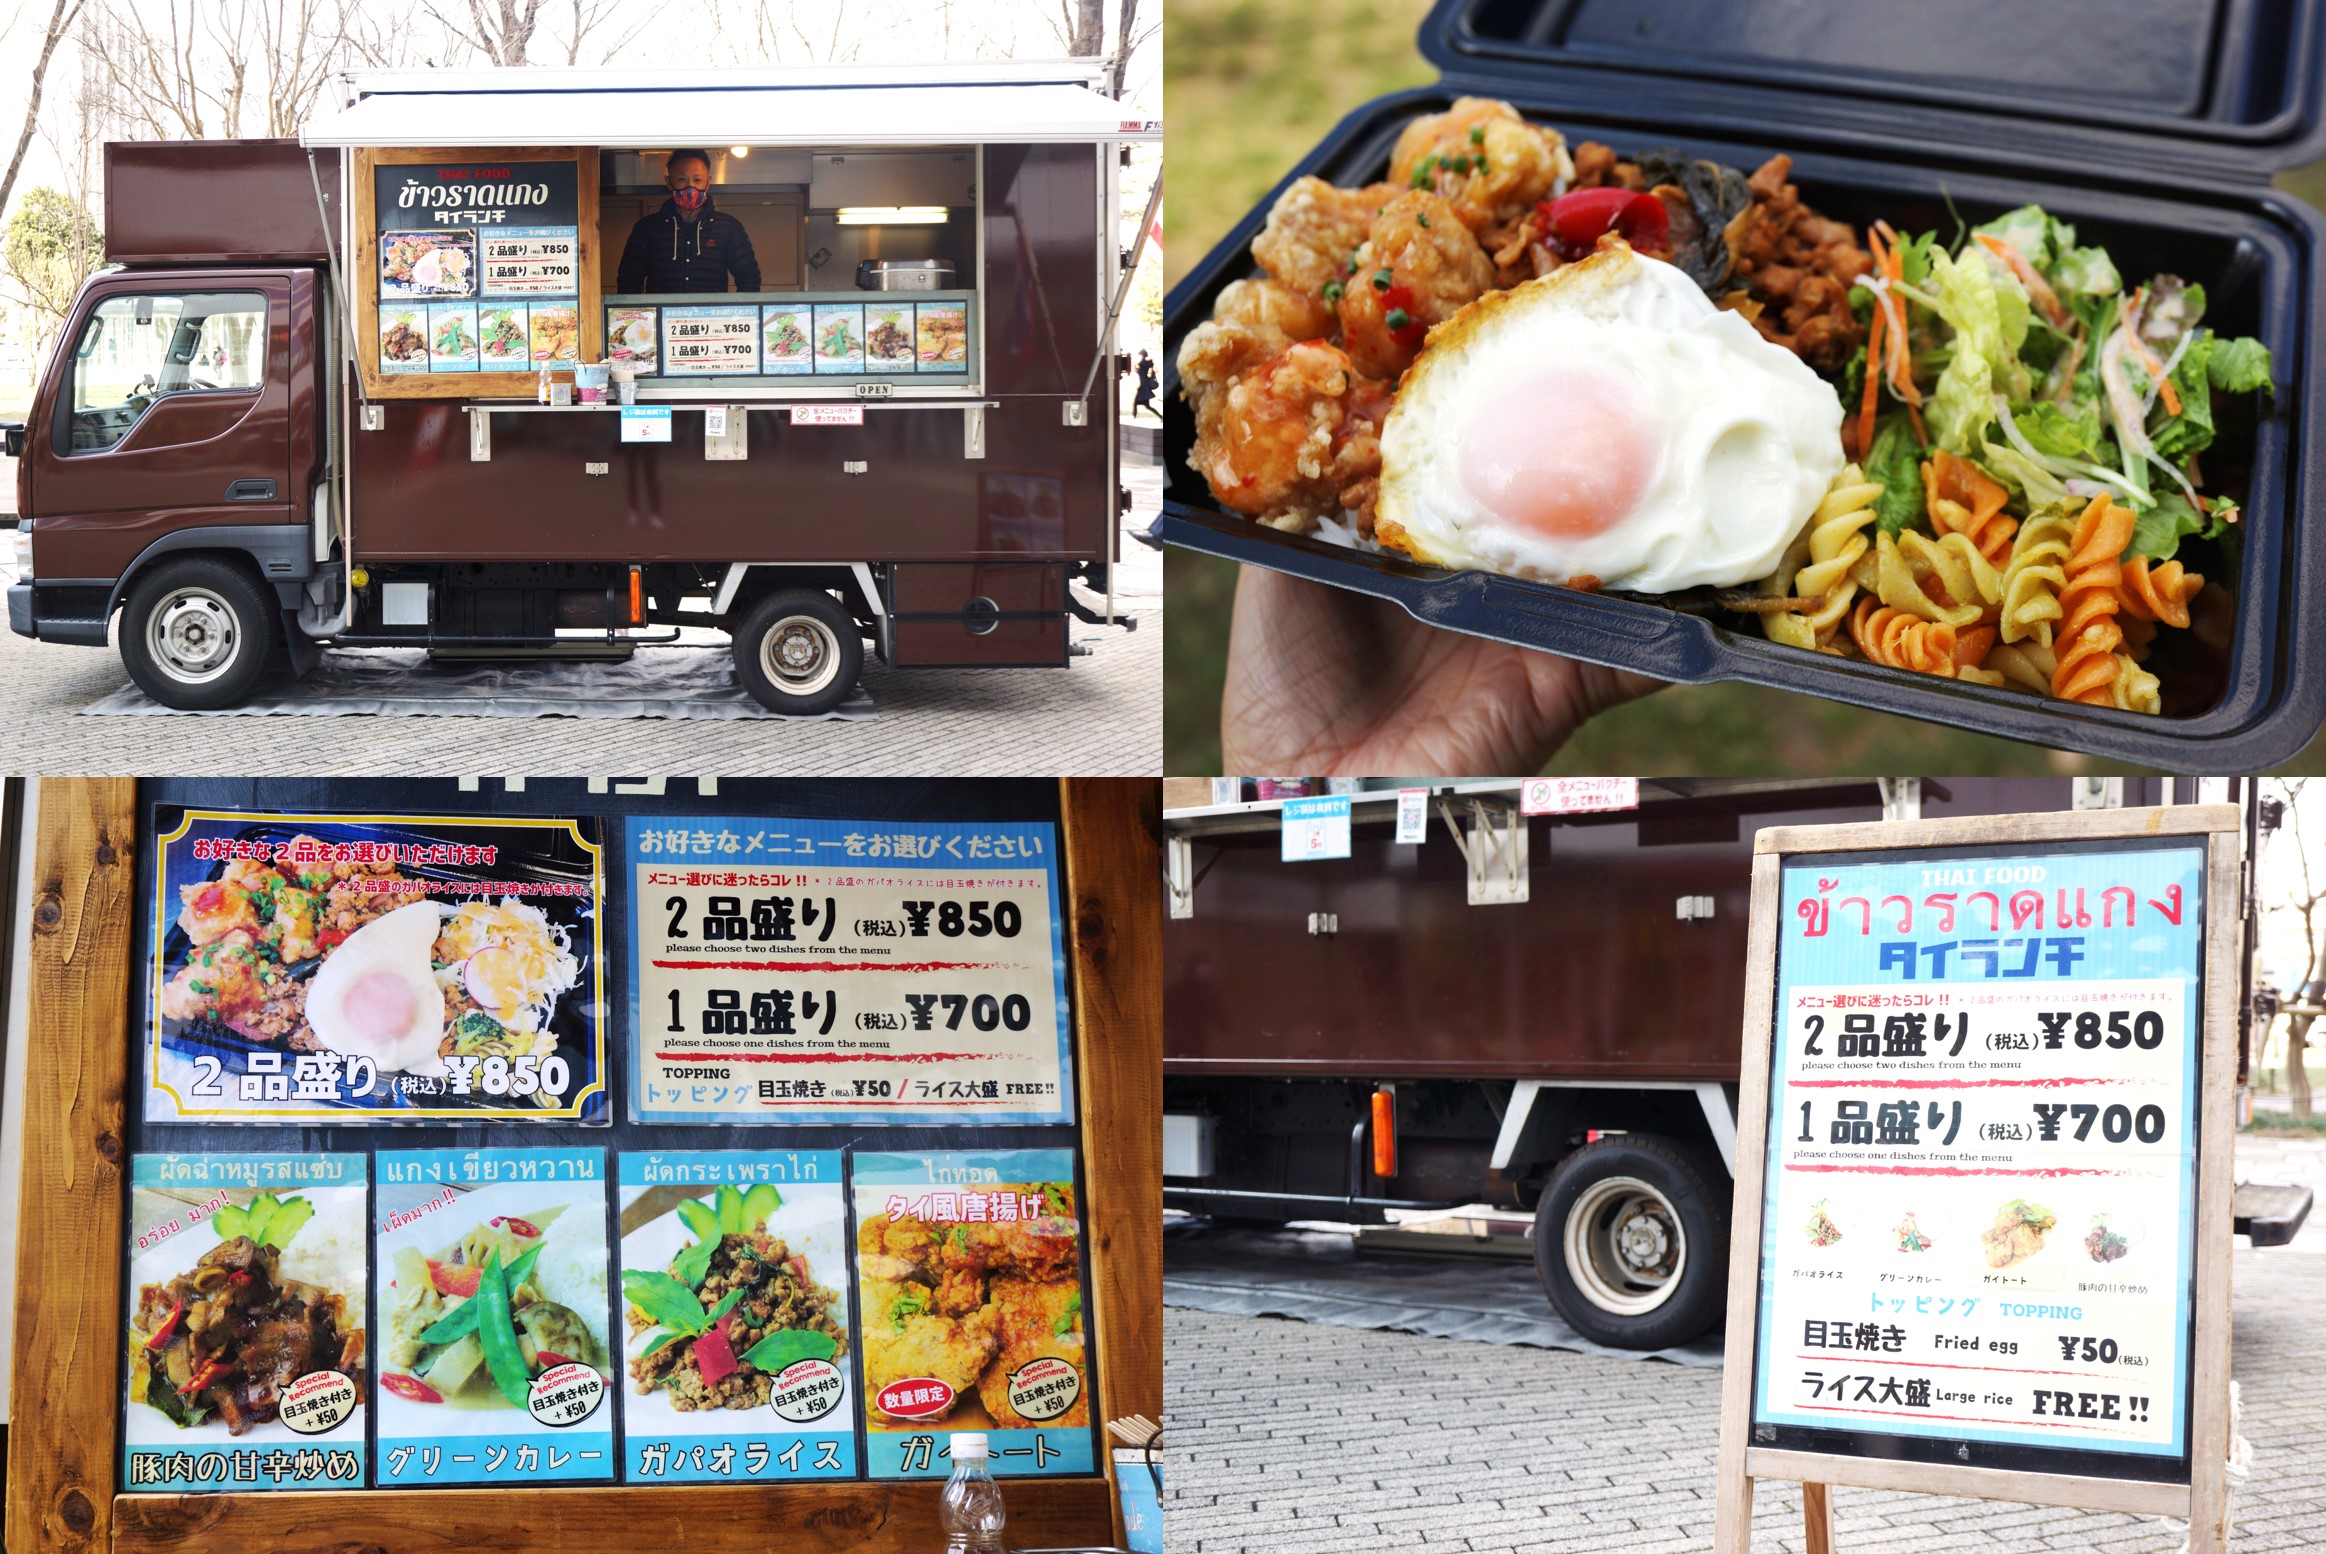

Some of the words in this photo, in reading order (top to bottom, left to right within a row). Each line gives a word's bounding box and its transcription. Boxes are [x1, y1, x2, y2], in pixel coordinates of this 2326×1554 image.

[438, 168, 470, 180] THAI
[474, 167, 511, 179] FOOD
[398, 178, 549, 208] ข้าวราดแกง
[434, 209, 506, 224] タイランチ
[542, 245, 569, 254] ¥850
[542, 266, 570, 275] ¥700
[723, 324, 751, 333] ¥850
[723, 345, 752, 354] ¥700
[859, 385, 889, 394] OPEN
[193, 838, 498, 866] お好きな2品をお選びいただけます
[639, 829, 1043, 860] お好きなメニューをお選びください
[648, 872, 807, 887] メニュー選びに迷ったらコレ!!
[1921, 869, 1975, 887] THAI
[1984, 865, 2047, 885] FOOD
[665, 896, 836, 942] 2品盛り
[854, 919, 906, 937] (税込)
[902, 900, 1022, 938] ¥850
[1796, 876, 2183, 938] ข้าวราดแกง
[665, 943, 702, 954] please
[704, 944, 742, 953] choose
[745, 945, 766, 953] two
[769, 944, 806, 954] dishes
[808, 945, 836, 954] from
[838, 945, 857, 954] the
[860, 947, 891, 955] menu
[1878, 936, 2086, 980] タイランチ
[667, 988, 837, 1035] 1品盛り
[854, 1012, 907, 1031] (税込)
[905, 993, 1031, 1032] ¥700
[664, 1038, 700, 1048] please
[702, 1038, 741, 1048] choose
[744, 1040, 764, 1048] one
[766, 1038, 804, 1048] dishes
[807, 1039, 835, 1048] from
[837, 1039, 856, 1048] the
[859, 1040, 891, 1049] menu
[1803, 1011, 1969, 1057] 2品盛り
[1985, 1033, 2040, 1051] (税込)
[2037, 1010, 2164, 1050] ¥850
[191, 1051, 377, 1102] 2品盛り
[391, 1076, 447, 1096] (税込)
[443, 1055, 570, 1097] ¥850
[663, 1067, 731, 1079] TOPPING
[1801, 1061, 1835, 1071] please
[1837, 1061, 1873, 1069] choose
[1876, 1061, 1896, 1069] two
[1899, 1061, 1935, 1069] dishes
[1938, 1061, 1965, 1069] from
[1968, 1061, 1987, 1069] the
[648, 1083, 753, 1105] トッピング
[758, 1080, 827, 1098] 目玉焼き
[831, 1089, 854, 1098] (税込)
[853, 1080, 891, 1097] ¥50
[914, 1081, 999, 1098] ライス大盛
[1797, 1099, 1962, 1146] 1品盛り
[1979, 1122, 2033, 1141] (税込)
[2033, 1103, 2166, 1144] ¥700
[387, 1152, 594, 1182] แกงเขียวหวาน
[643, 1154, 818, 1182] ผัดกระเพราไก่
[1793, 1150, 1827, 1160] please
[1829, 1150, 1865, 1159] choose
[1890, 1151, 1926, 1160] dishes
[1929, 1152, 1957, 1161] from
[1959, 1152, 1979, 1161] the
[1981, 1154, 2013, 1162] menu
[159, 1154, 342, 1187] ผัดฉ่าหมูรสแซ่บ
[922, 1155, 999, 1184] ไก่ทอด
[137, 1218, 180, 1249] อร่อย
[188, 1190, 231, 1222] มาก!
[886, 1191, 1046, 1224] タイ風唐揚げ
[1879, 1273, 1942, 1284] グリーンカレー
[1983, 1275, 2027, 1286] ガイトート
[1871, 1291, 1981, 1318] トッピング
[1999, 1302, 2083, 1320] TOPPING
[1803, 1319, 1907, 1352] 目玉焼き
[1934, 1334, 1980, 1351] Fried
[1989, 1341, 2019, 1355] egg
[2058, 1335, 2119, 1364] ¥50
[2117, 1355, 2149, 1366] (税込)
[295, 1372, 330, 1389] Special
[542, 1364, 577, 1382] Special
[778, 1367, 831, 1391] Recommend
[783, 1361, 817, 1378] Special
[1016, 1366, 1068, 1389] Recommend
[1021, 1360, 1054, 1378] Special
[288, 1378, 344, 1402] Recommend
[537, 1370, 591, 1395] Recommend
[774, 1376, 840, 1408] 目玉焼き付き
[1013, 1375, 1077, 1406] 目玉焼き付き
[1801, 1371, 1931, 1408] ライス大盛
[1936, 1388, 1976, 1404] Large
[1984, 1392, 2013, 1405] rice
[284, 1388, 353, 1419] 目玉焼き付き
[532, 1380, 600, 1412] 目玉焼き付き
[806, 1396, 828, 1414] ¥50
[884, 1386, 946, 1409] 数量限定
[1045, 1396, 1065, 1413] ¥50
[317, 1408, 338, 1427] ¥50
[565, 1400, 587, 1418] ¥50
[387, 1444, 602, 1477] グリーンカレー
[639, 1440, 843, 1476] ガパオライス
[900, 1434, 1061, 1472] ガート
[130, 1449, 360, 1485] 豚肉の甘辛炒め
